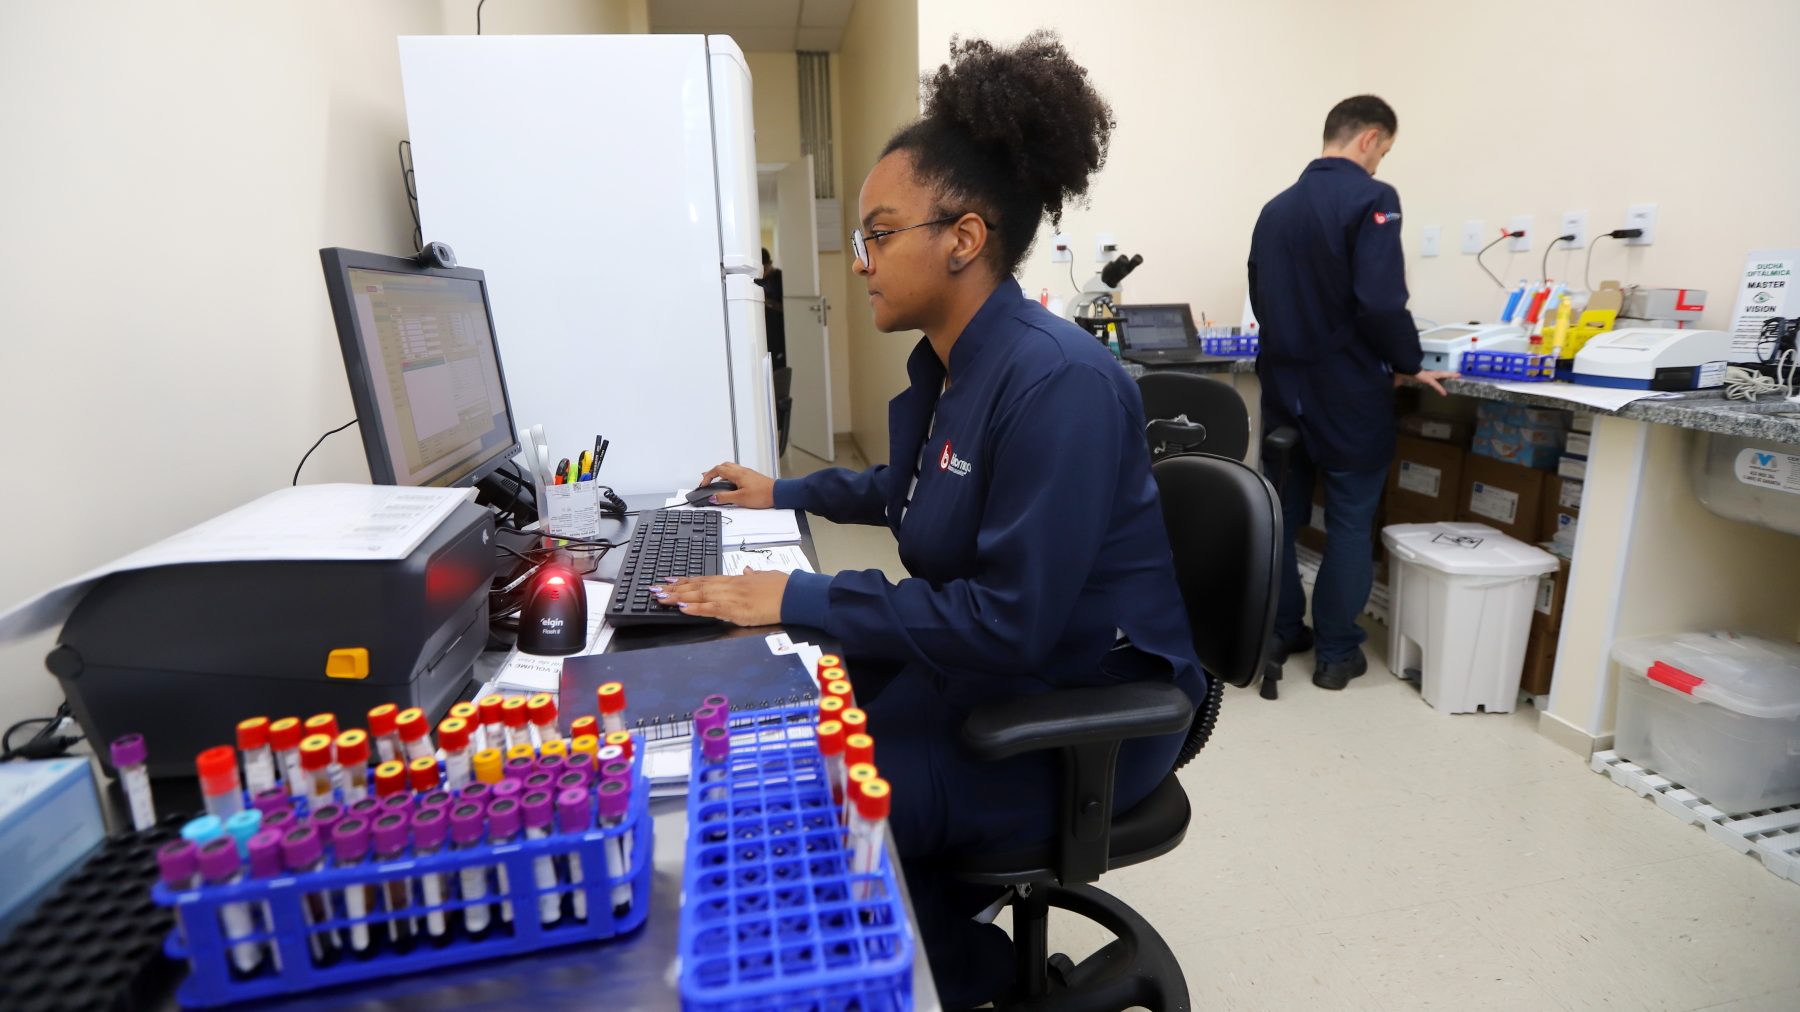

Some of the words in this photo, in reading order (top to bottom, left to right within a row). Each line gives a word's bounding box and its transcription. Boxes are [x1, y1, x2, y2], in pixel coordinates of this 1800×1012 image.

[1757, 262, 1784, 270] DUCHA
[1747, 281, 1785, 289] MASTER
[1746, 305, 1776, 313] VISION
[541, 617, 564, 628] elgin
